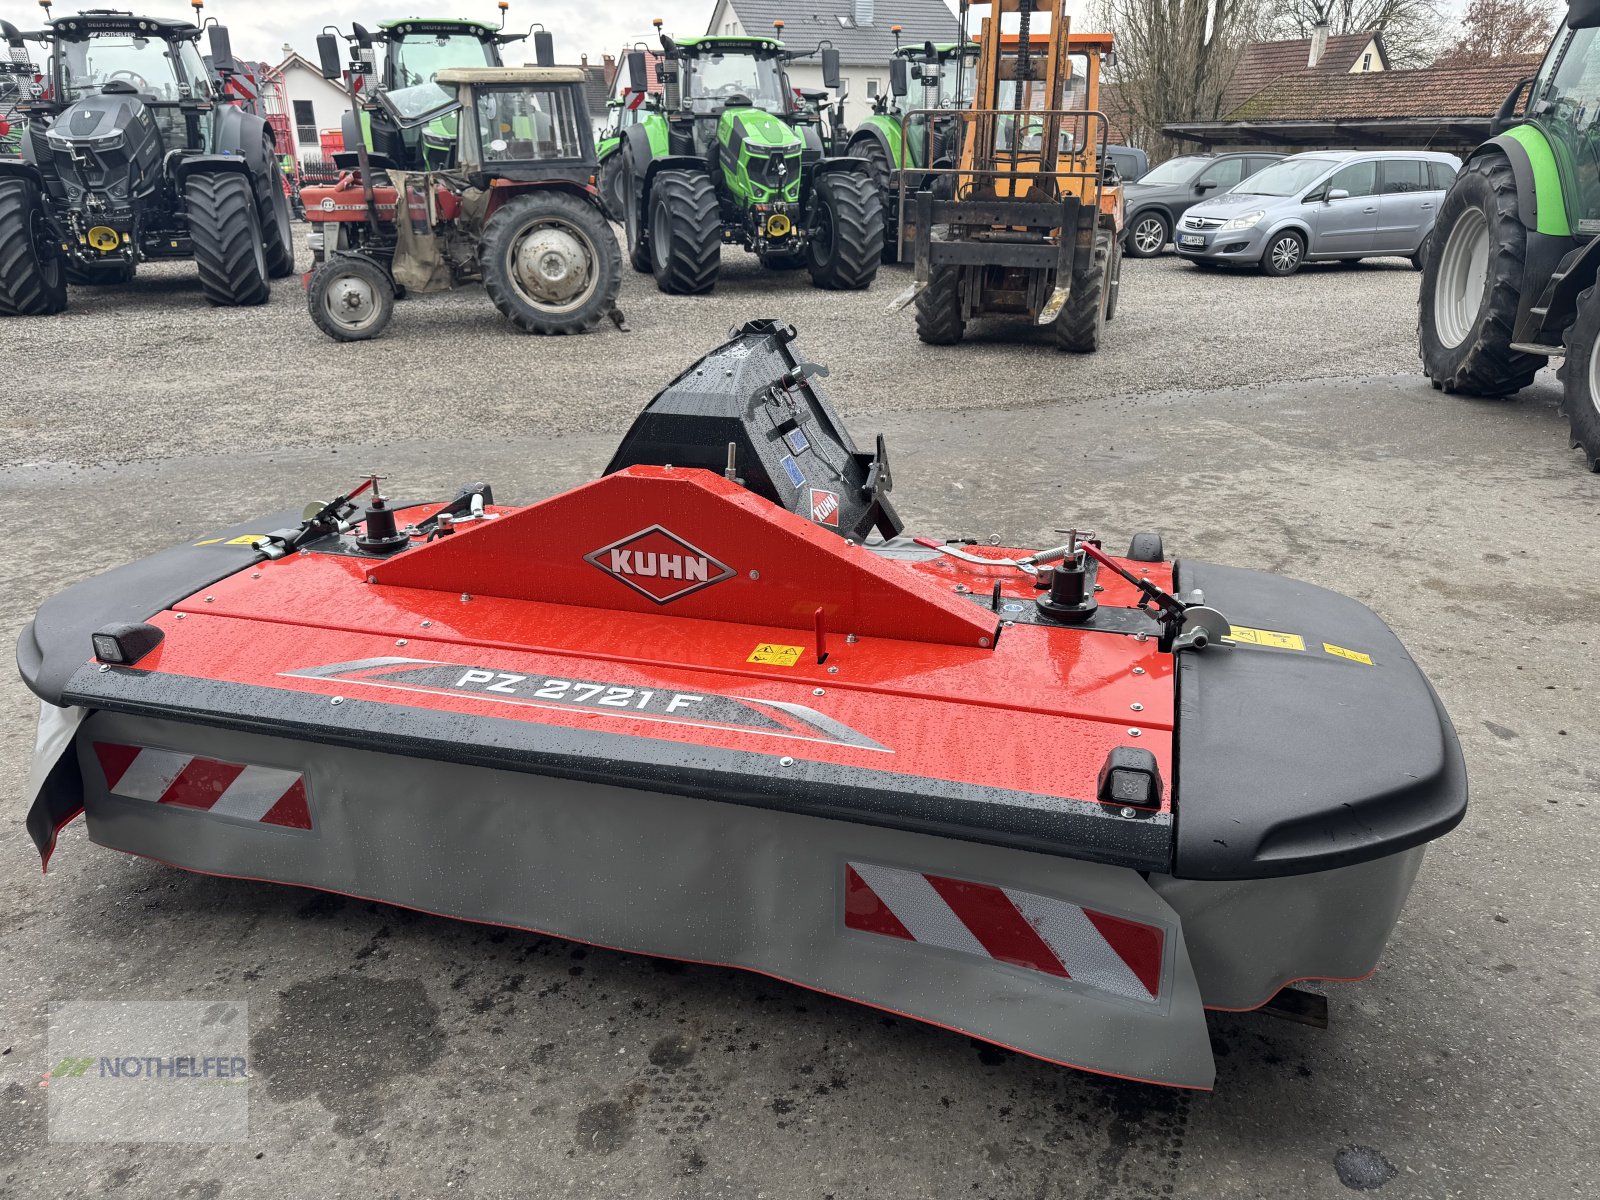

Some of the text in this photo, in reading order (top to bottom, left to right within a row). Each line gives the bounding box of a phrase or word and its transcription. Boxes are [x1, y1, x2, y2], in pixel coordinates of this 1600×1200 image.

[813, 493, 839, 523] KUHN
[610, 548, 709, 582] KUHN
[455, 669, 704, 713] PZ 2721 F
